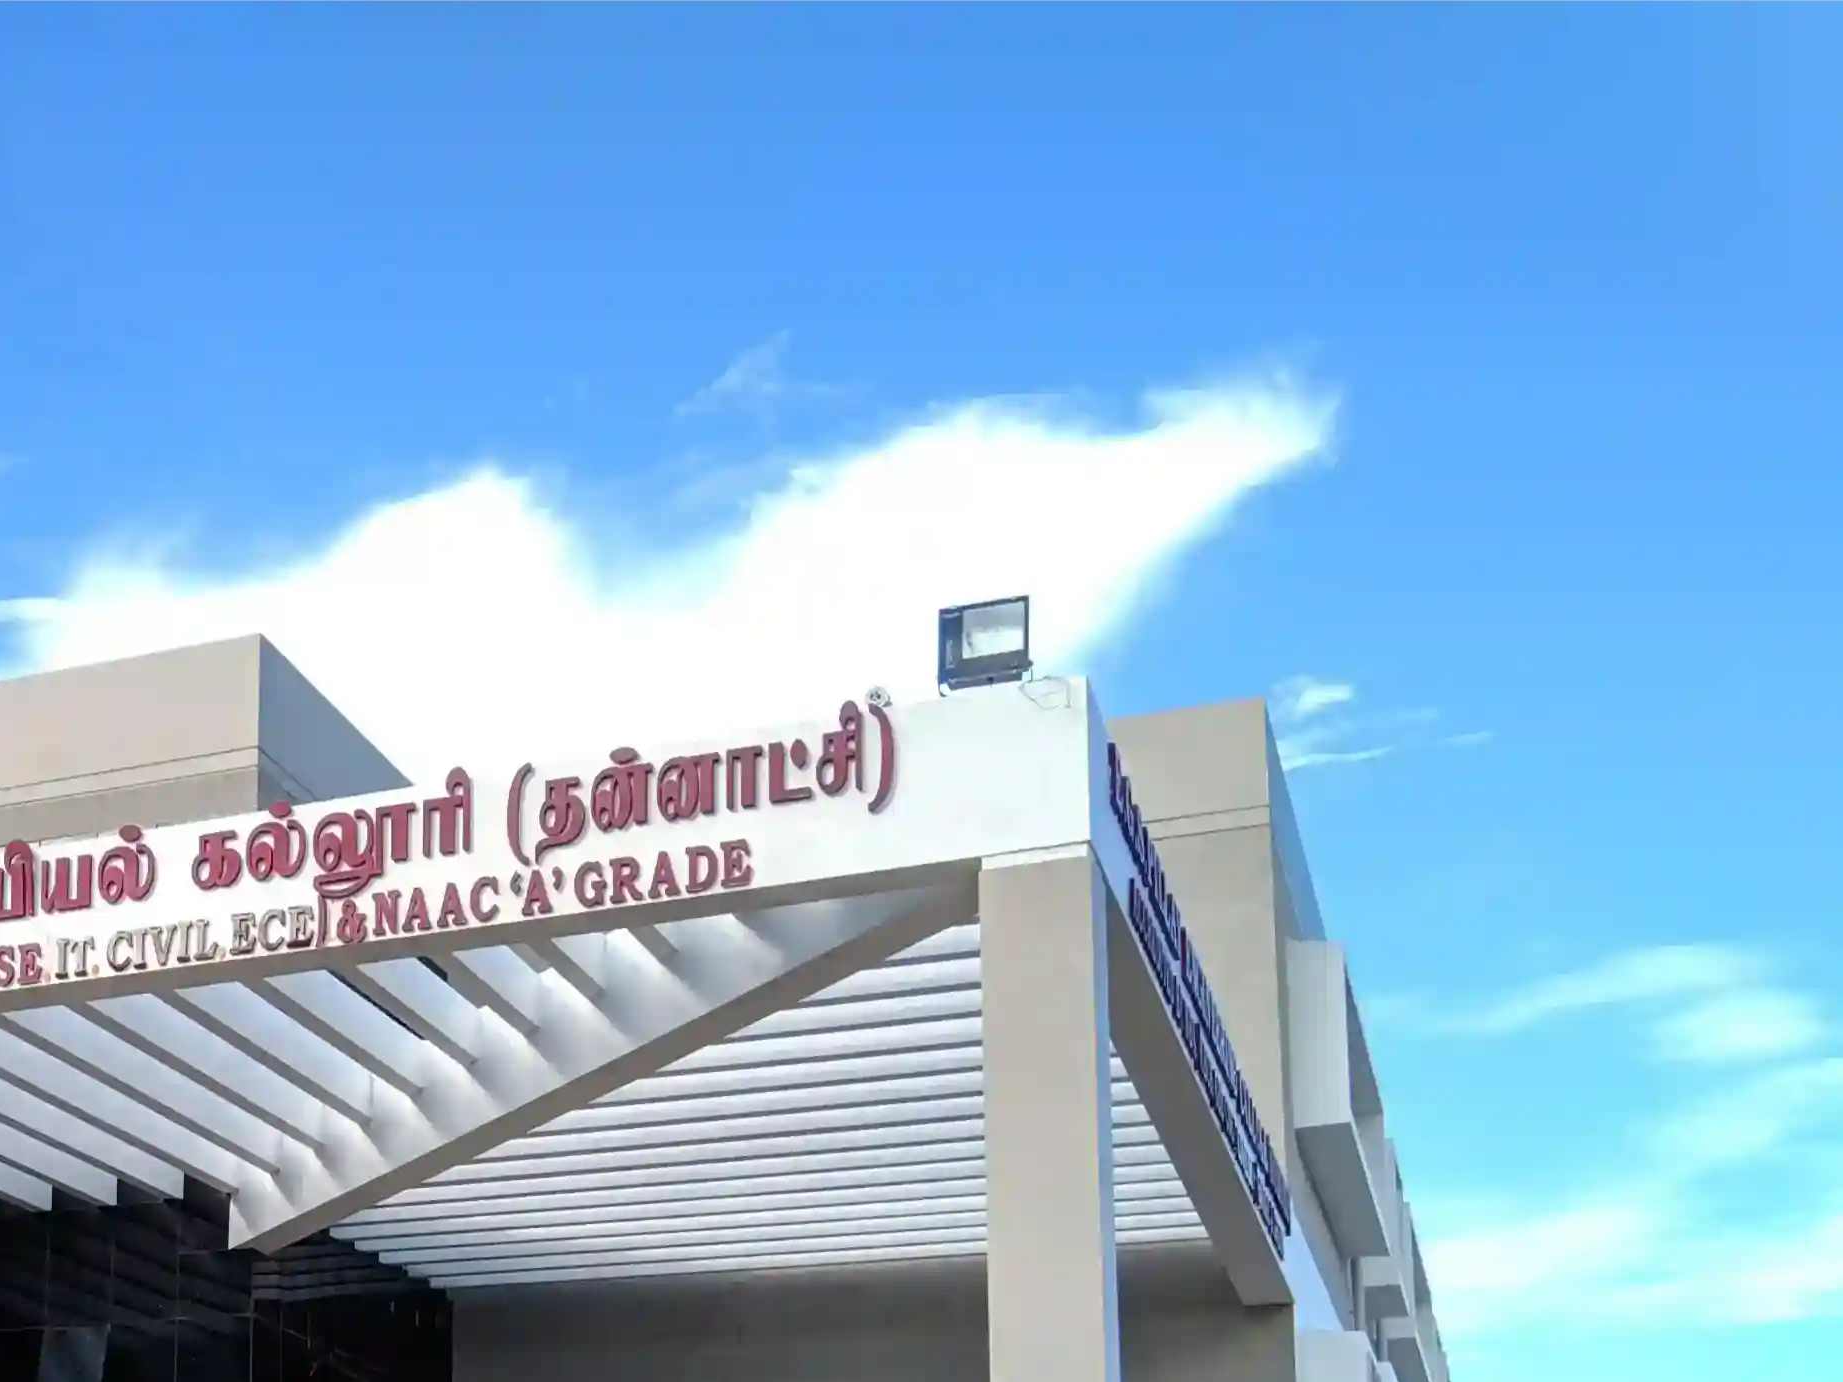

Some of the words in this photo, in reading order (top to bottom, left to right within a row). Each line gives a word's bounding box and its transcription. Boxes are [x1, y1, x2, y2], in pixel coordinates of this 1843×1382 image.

[191, 766, 473, 898] கல்லூரி
[506, 701, 897, 866] (தன்னாட்சி)
[336, 899, 367, 944] &
[372, 874, 501, 937] NAAC
[574, 838, 755, 908] GRADE
